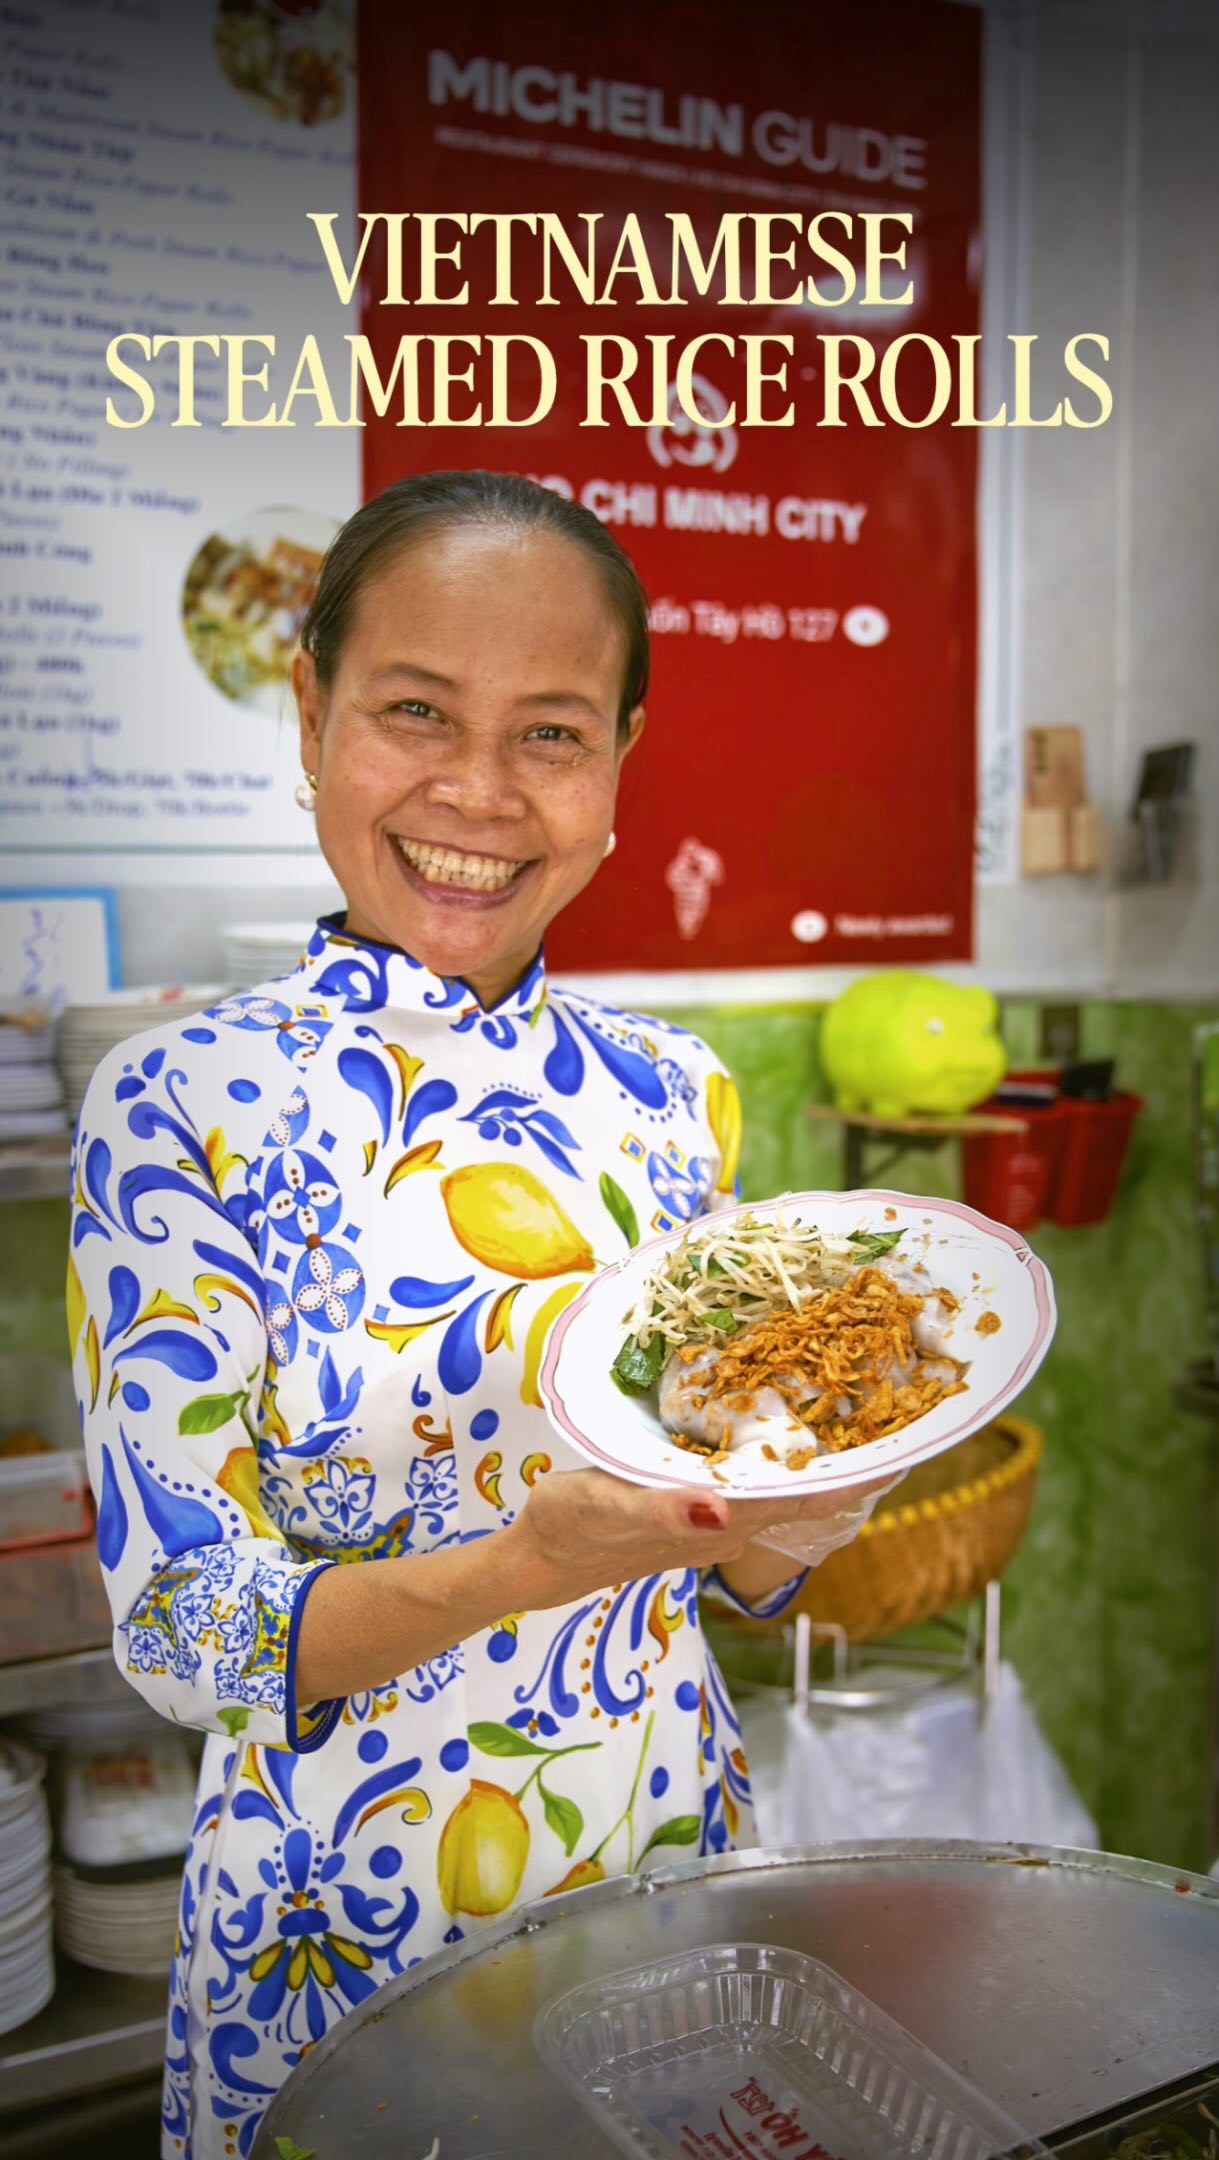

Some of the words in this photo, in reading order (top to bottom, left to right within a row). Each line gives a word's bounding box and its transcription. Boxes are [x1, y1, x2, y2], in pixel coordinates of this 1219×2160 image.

[427, 49, 744, 158] MICHELIN
[752, 110, 926, 191] GUIDE
[581, 479, 657, 527] CHI
[664, 486, 770, 536] MINH
[775, 495, 867, 544] CITY
[788, 607, 840, 641] 127
